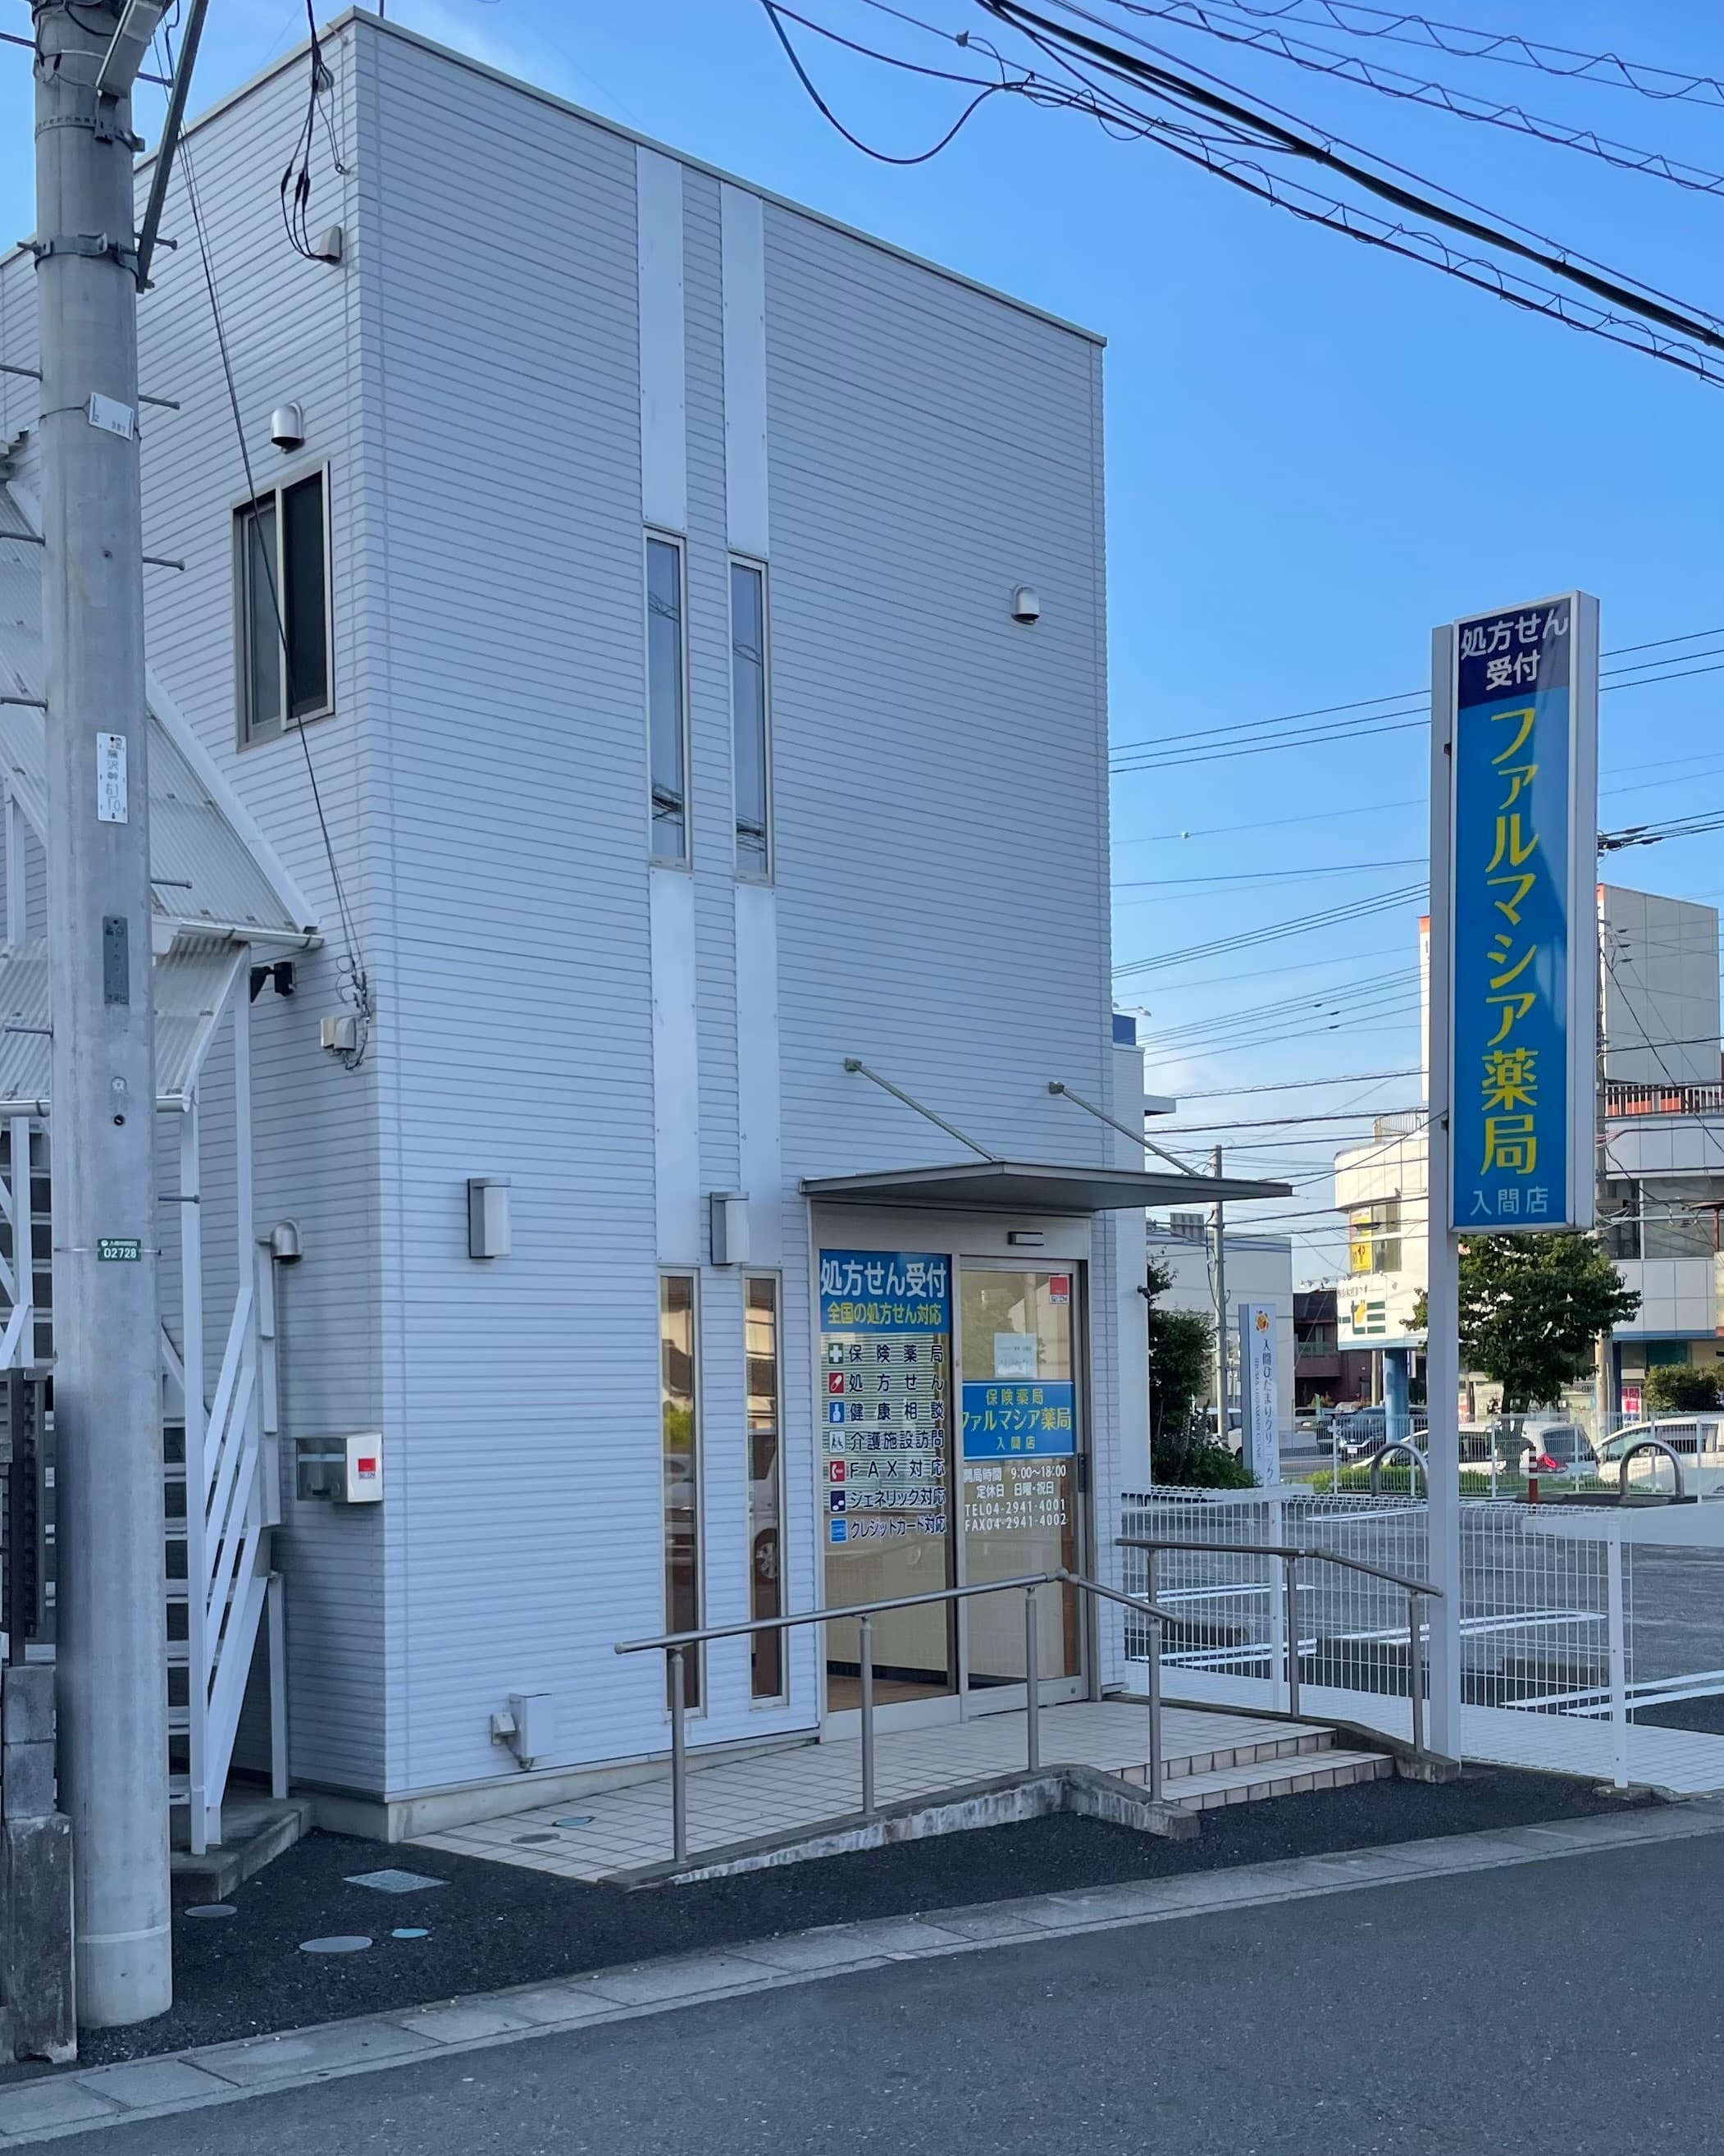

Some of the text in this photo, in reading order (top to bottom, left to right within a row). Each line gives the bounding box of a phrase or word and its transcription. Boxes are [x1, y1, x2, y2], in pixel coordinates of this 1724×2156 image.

[1461, 608, 1568, 660] 処方せん
[1485, 649, 1541, 691] 受付
[1480, 706, 1539, 1176] ファルマシア薬局
[1470, 1185, 1548, 1217] 入間店
[103, 1247, 137, 1258] 02728
[821, 1258, 946, 1298] 処方せん受付
[828, 1301, 942, 1326] 全国の処方せん対応
[849, 1344, 943, 1363] 保険薬局
[849, 1373, 944, 1392] 処方せん
[986, 1388, 1044, 1406] 保険薬局
[850, 1401, 944, 1422] 健康相談
[851, 1429, 944, 1451] 介護施設訪問
[997, 1436, 1036, 1450] 入間店
[851, 1487, 946, 1509] ジェネリック対応
[976, 1483, 1005, 1499] 定休日
[851, 1514, 947, 1539] クレジットカード対応
